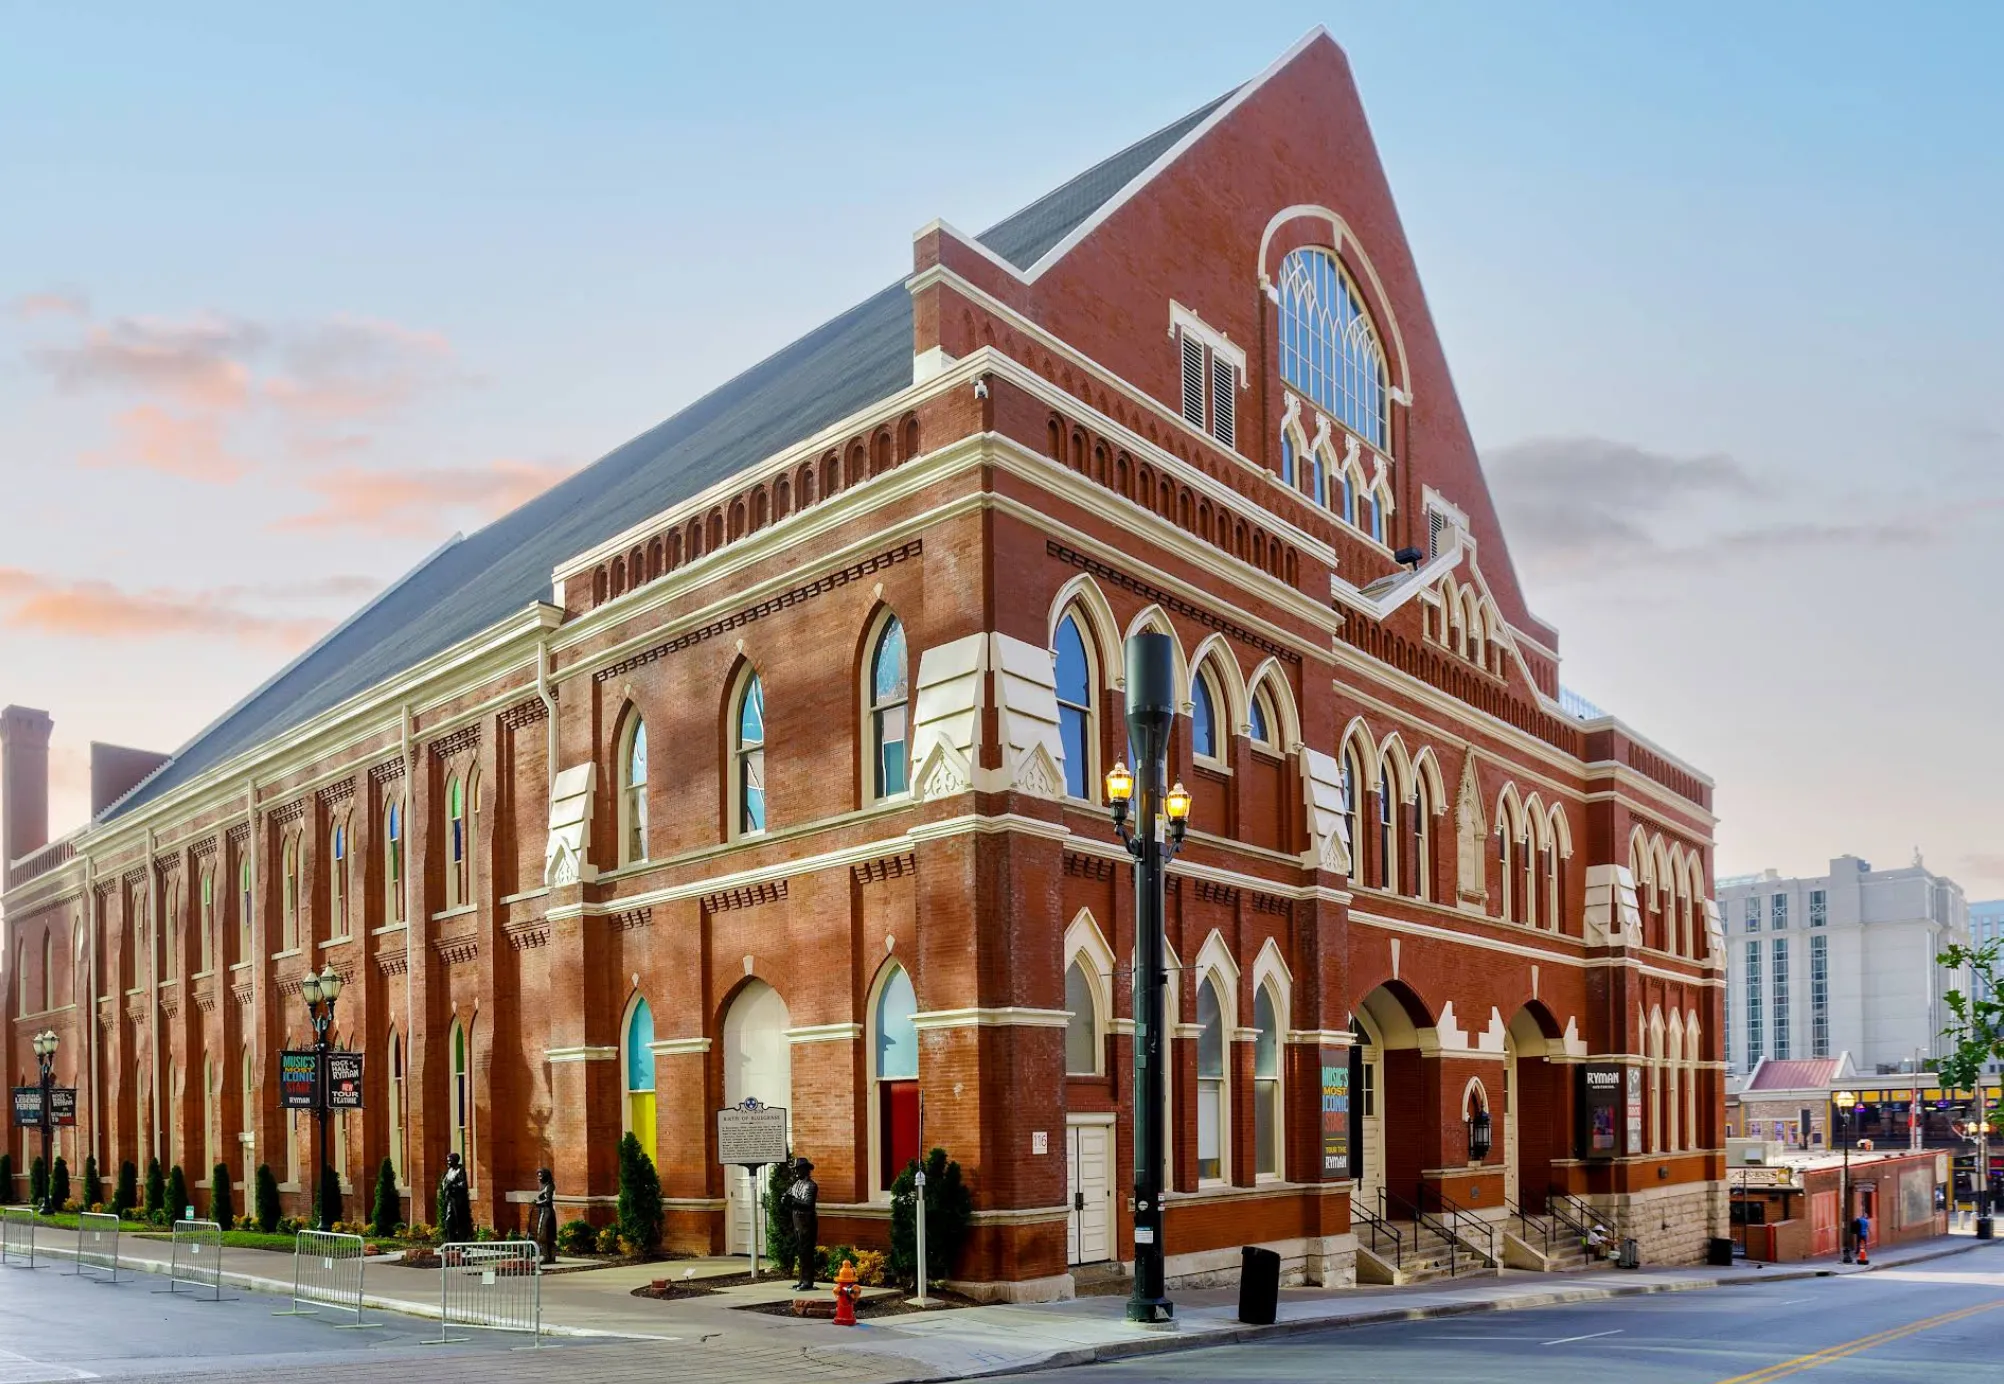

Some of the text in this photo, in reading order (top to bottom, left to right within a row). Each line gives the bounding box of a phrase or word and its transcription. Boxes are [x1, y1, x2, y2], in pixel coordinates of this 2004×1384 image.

[283, 1056, 316, 1068] MUSIC'S
[283, 1072, 316, 1082] ICONIC
[333, 1069, 359, 1080] RYMAN
[1322, 1067, 1349, 1087] MUSIC'S
[1587, 1072, 1619, 1084] RYMAN
[286, 1082, 312, 1093] STAGE
[1324, 1087, 1347, 1095] MOST
[1322, 1095, 1349, 1112] ICONIC
[1325, 1112, 1345, 1132] STAGE
[1034, 1134, 1046, 1146] 116
[1325, 1156, 1347, 1169] RYMAN
